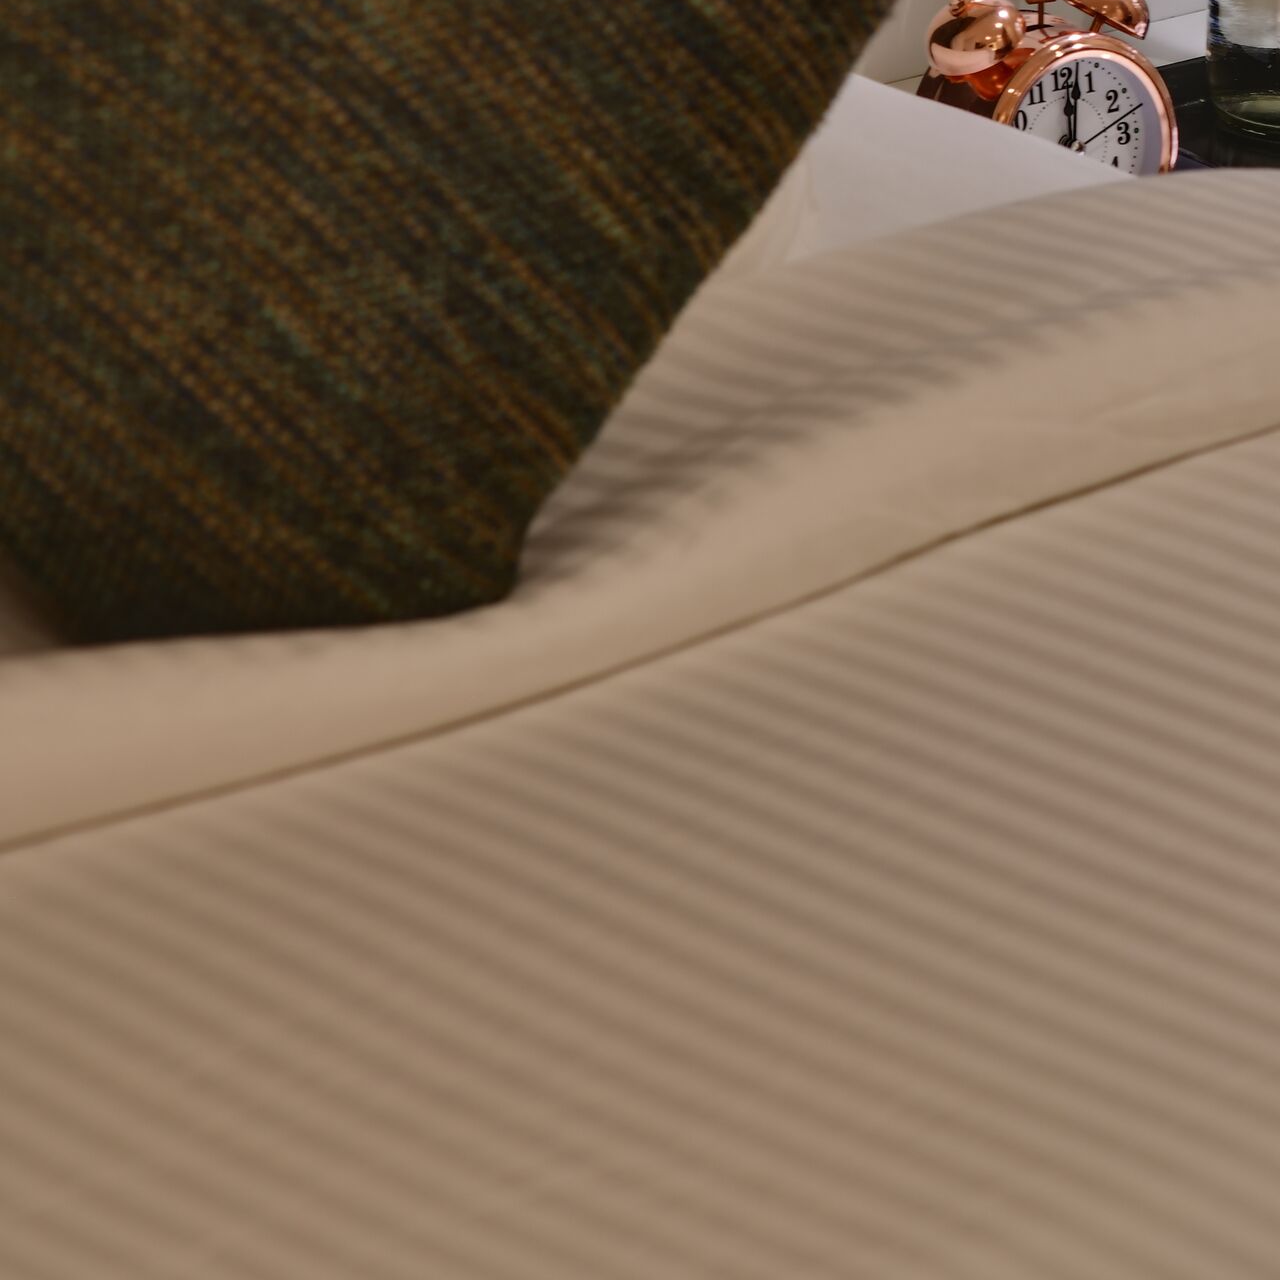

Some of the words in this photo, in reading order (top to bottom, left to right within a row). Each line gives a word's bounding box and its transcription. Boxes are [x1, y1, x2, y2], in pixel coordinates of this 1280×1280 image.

[1051, 67, 1073, 92] 12
[1085, 71, 1095, 93] 1
[1028, 81, 1046, 105] 11
[1106, 89, 1119, 113] 2
[1014, 110, 1027, 131] 0
[1117, 122, 1131, 145] 3
